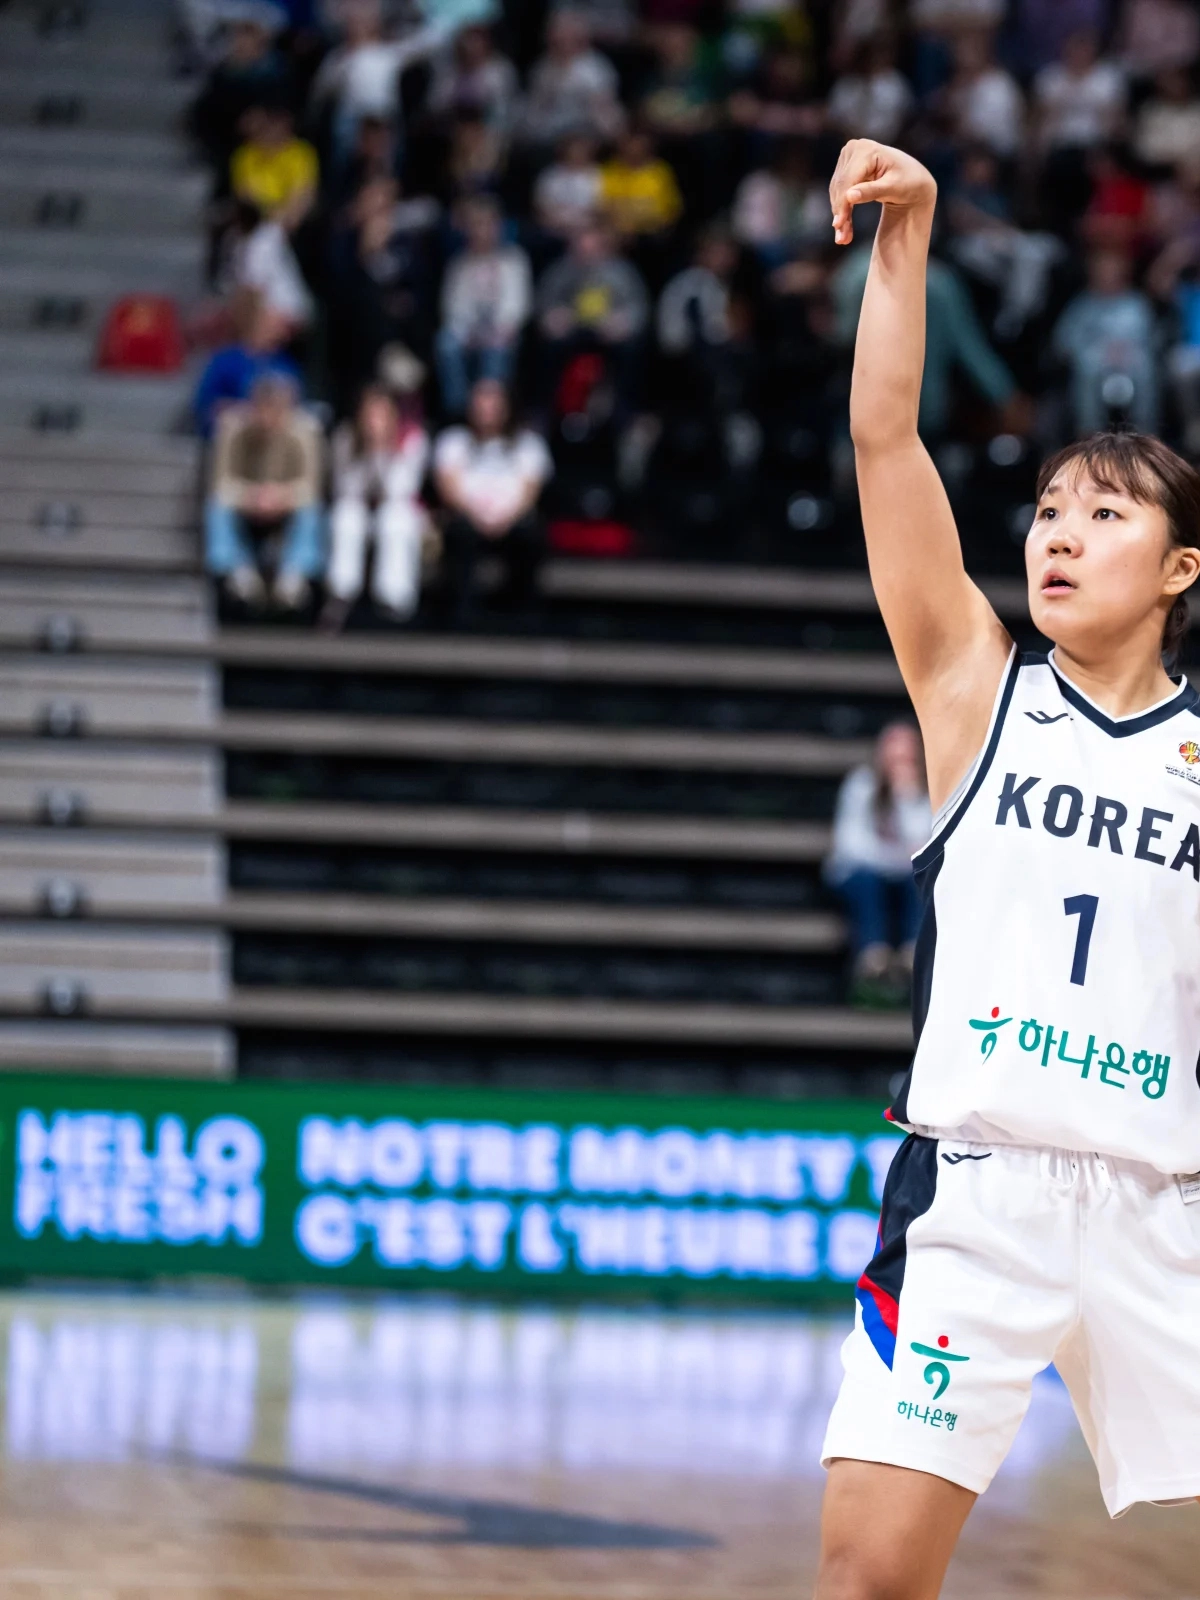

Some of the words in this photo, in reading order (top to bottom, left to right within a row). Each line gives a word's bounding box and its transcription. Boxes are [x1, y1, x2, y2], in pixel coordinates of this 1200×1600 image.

[1063, 894, 1099, 986] 1
[1018, 1018, 1171, 1100] 하나은행
[17, 1109, 265, 1186] HELLO
[300, 1117, 559, 1192] NOTRE
[569, 1124, 856, 1204] MONEY
[16, 1182, 264, 1247] FRESH
[296, 1192, 511, 1271] C'EST
[517, 1200, 820, 1278] L'HEURE
[897, 1400, 958, 1431] 하나은행
